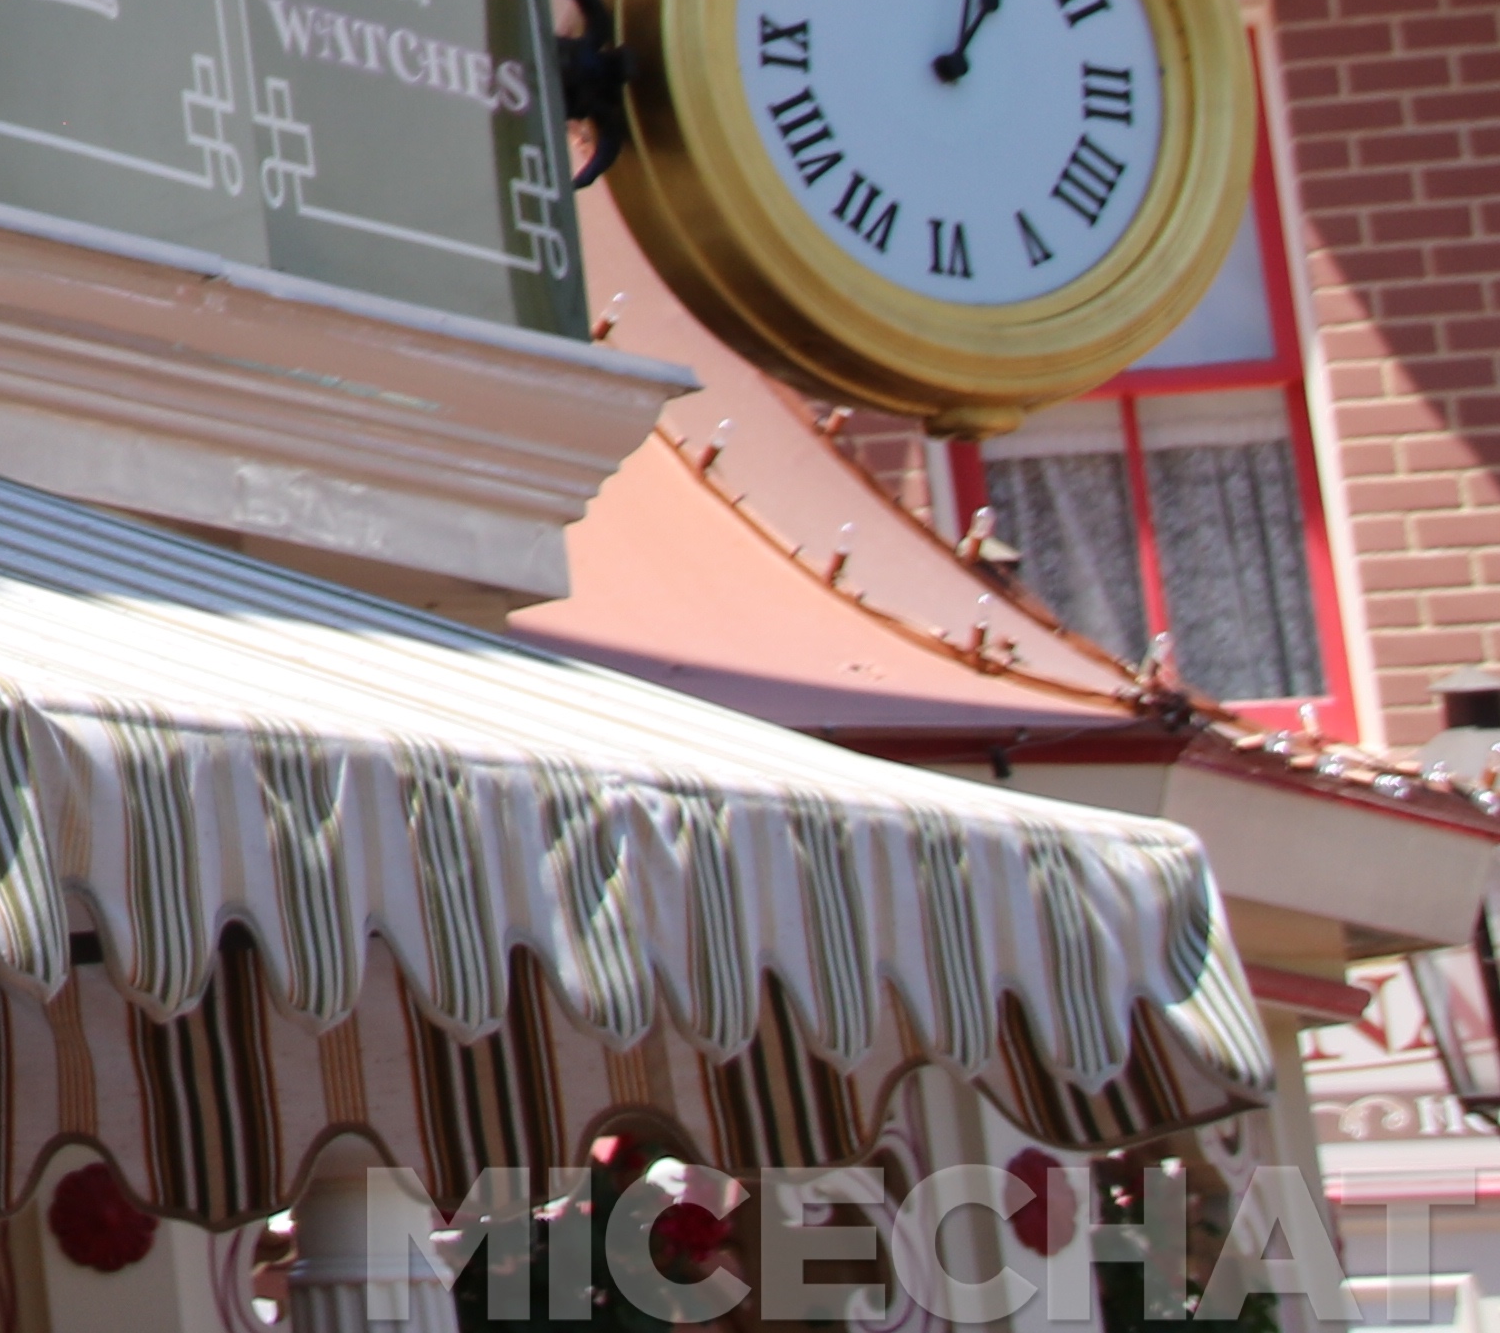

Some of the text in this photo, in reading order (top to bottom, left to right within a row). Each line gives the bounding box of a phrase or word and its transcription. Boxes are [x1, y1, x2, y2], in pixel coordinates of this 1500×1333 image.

[759, 14, 810, 73] IX
[1082, 61, 1132, 127] III
[768, 87, 845, 188] VIII
[831, 170, 900, 254] VII
[1050, 134, 1127, 227] IIII
[928, 218, 973, 279] VI
[1014, 209, 1054, 267] V
